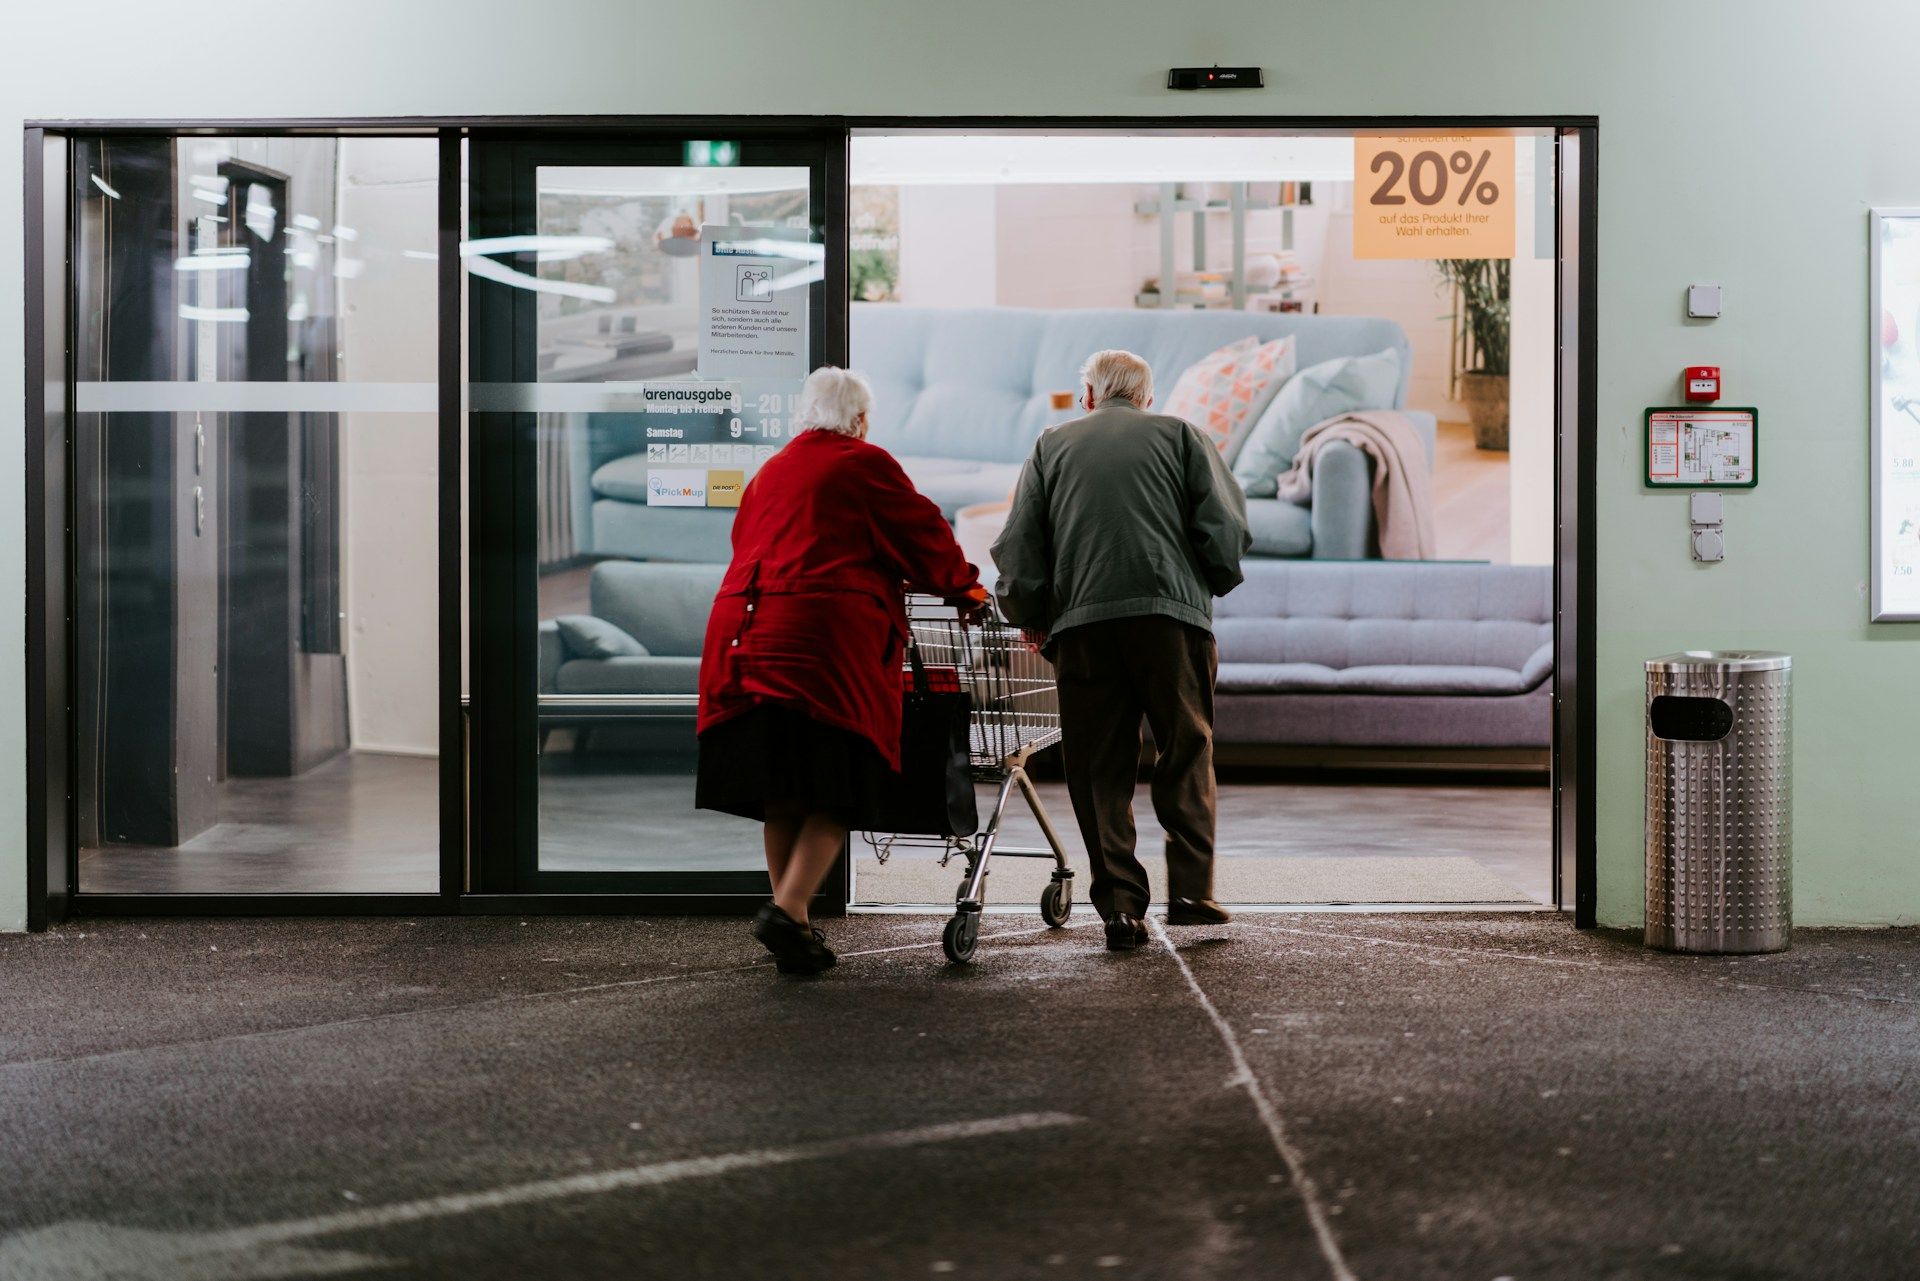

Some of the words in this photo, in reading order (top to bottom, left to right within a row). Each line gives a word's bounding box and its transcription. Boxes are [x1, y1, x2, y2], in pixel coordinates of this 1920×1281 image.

[1370, 150, 1499, 206] 20%
[1379, 213, 1396, 224] auf
[1400, 213, 1419, 224] das
[1422, 213, 1462, 224] Produkt
[1466, 213, 1489, 224] Ihrer
[1396, 226, 1422, 236] Wahl
[1426, 226, 1472, 236] erhalten.
[646, 404, 678, 415] Montag
[680, 404, 693, 414] bis
[694, 404, 724, 415] Freitag
[646, 427, 684, 439] Samstag
[661, 488, 704, 498] PickMup
